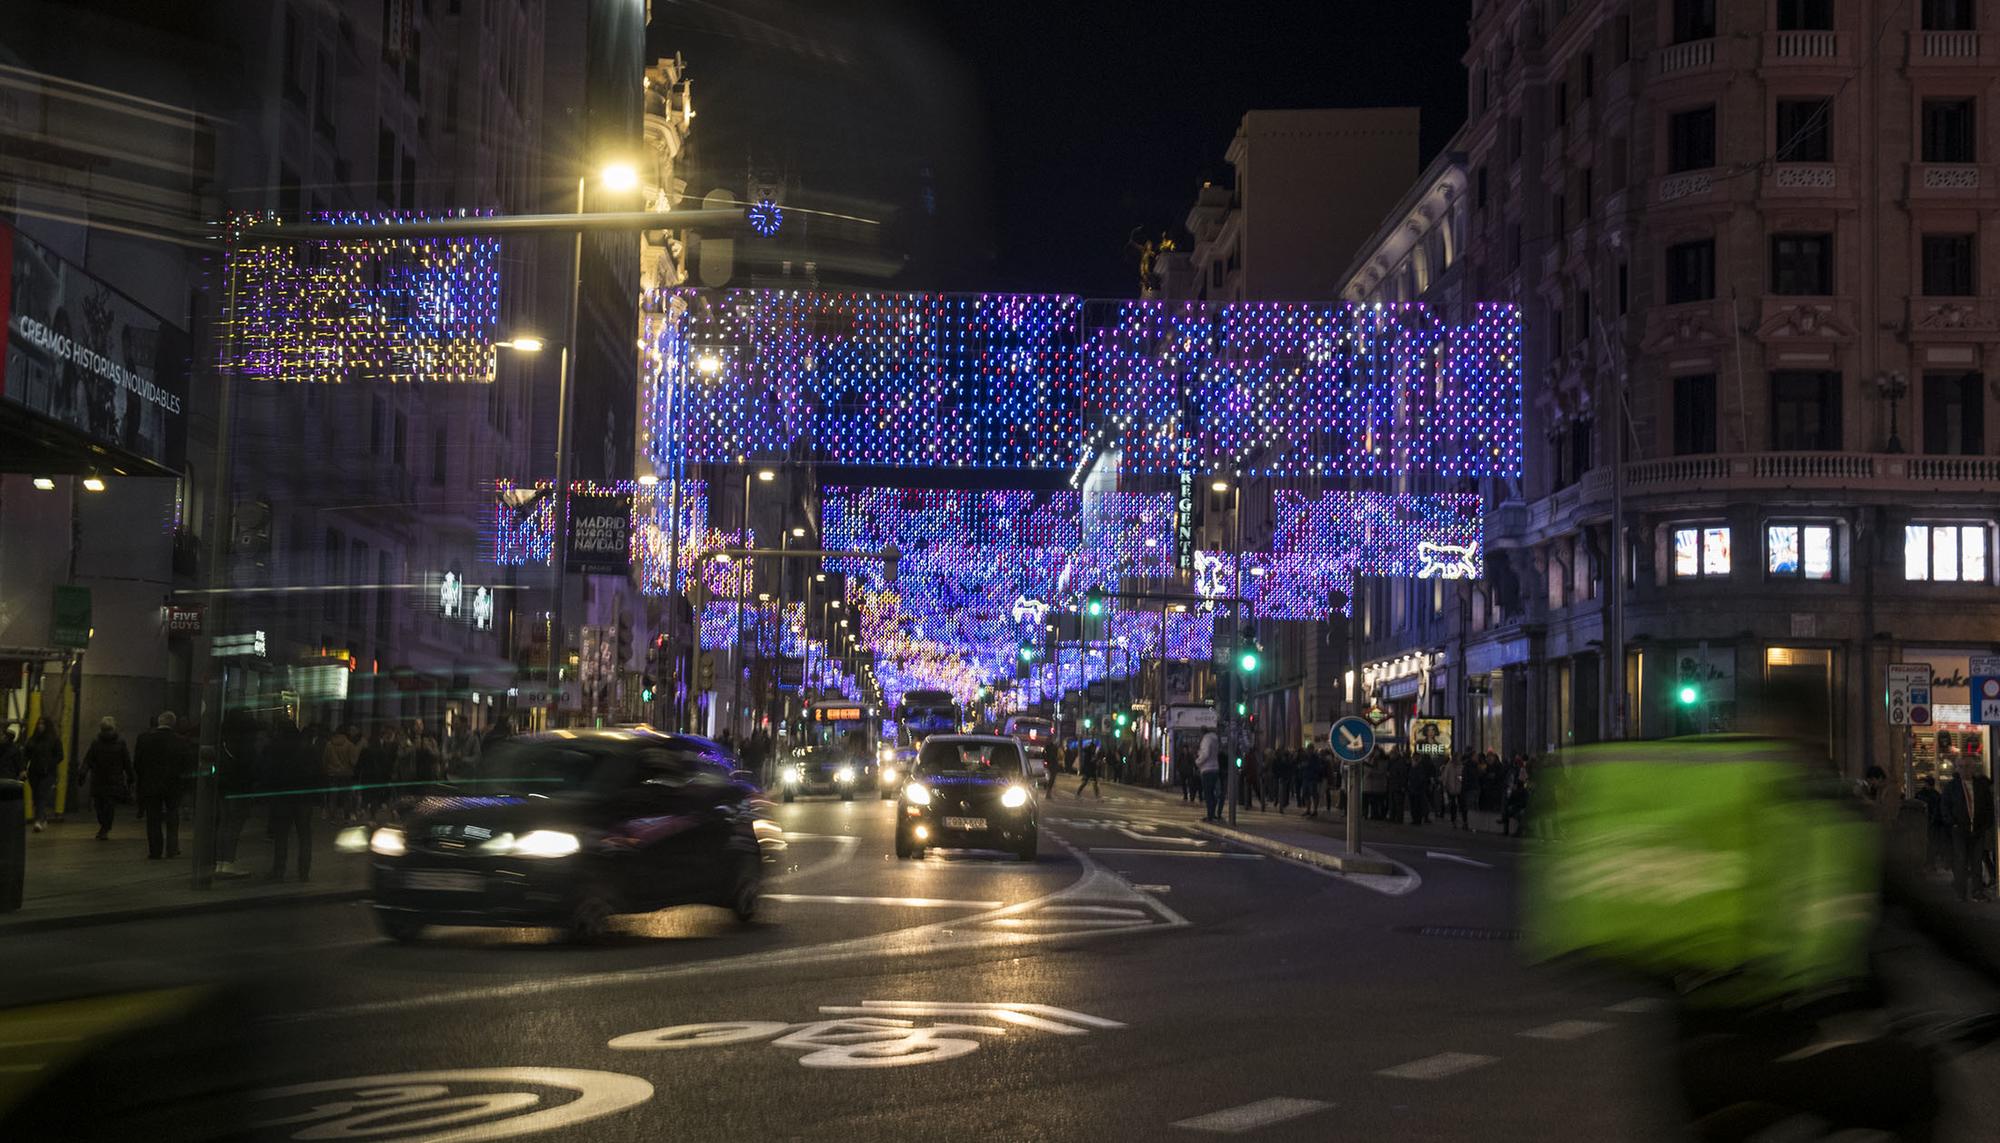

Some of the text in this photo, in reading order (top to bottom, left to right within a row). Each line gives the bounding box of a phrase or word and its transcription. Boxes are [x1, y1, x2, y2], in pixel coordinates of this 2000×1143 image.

[20, 315, 181, 415] CREAMOS HISTORIAS INOLVIDABLES
[576, 516, 625, 529] MADRID
[1179, 471, 1192, 568] REGENTE
[574, 538, 625, 551] NAVIDAD
[173, 612, 198, 621] FIVE
[170, 620, 200, 630] GUYS
[815, 708, 822, 721] 2
[1416, 743, 1445, 753] LIBRE
